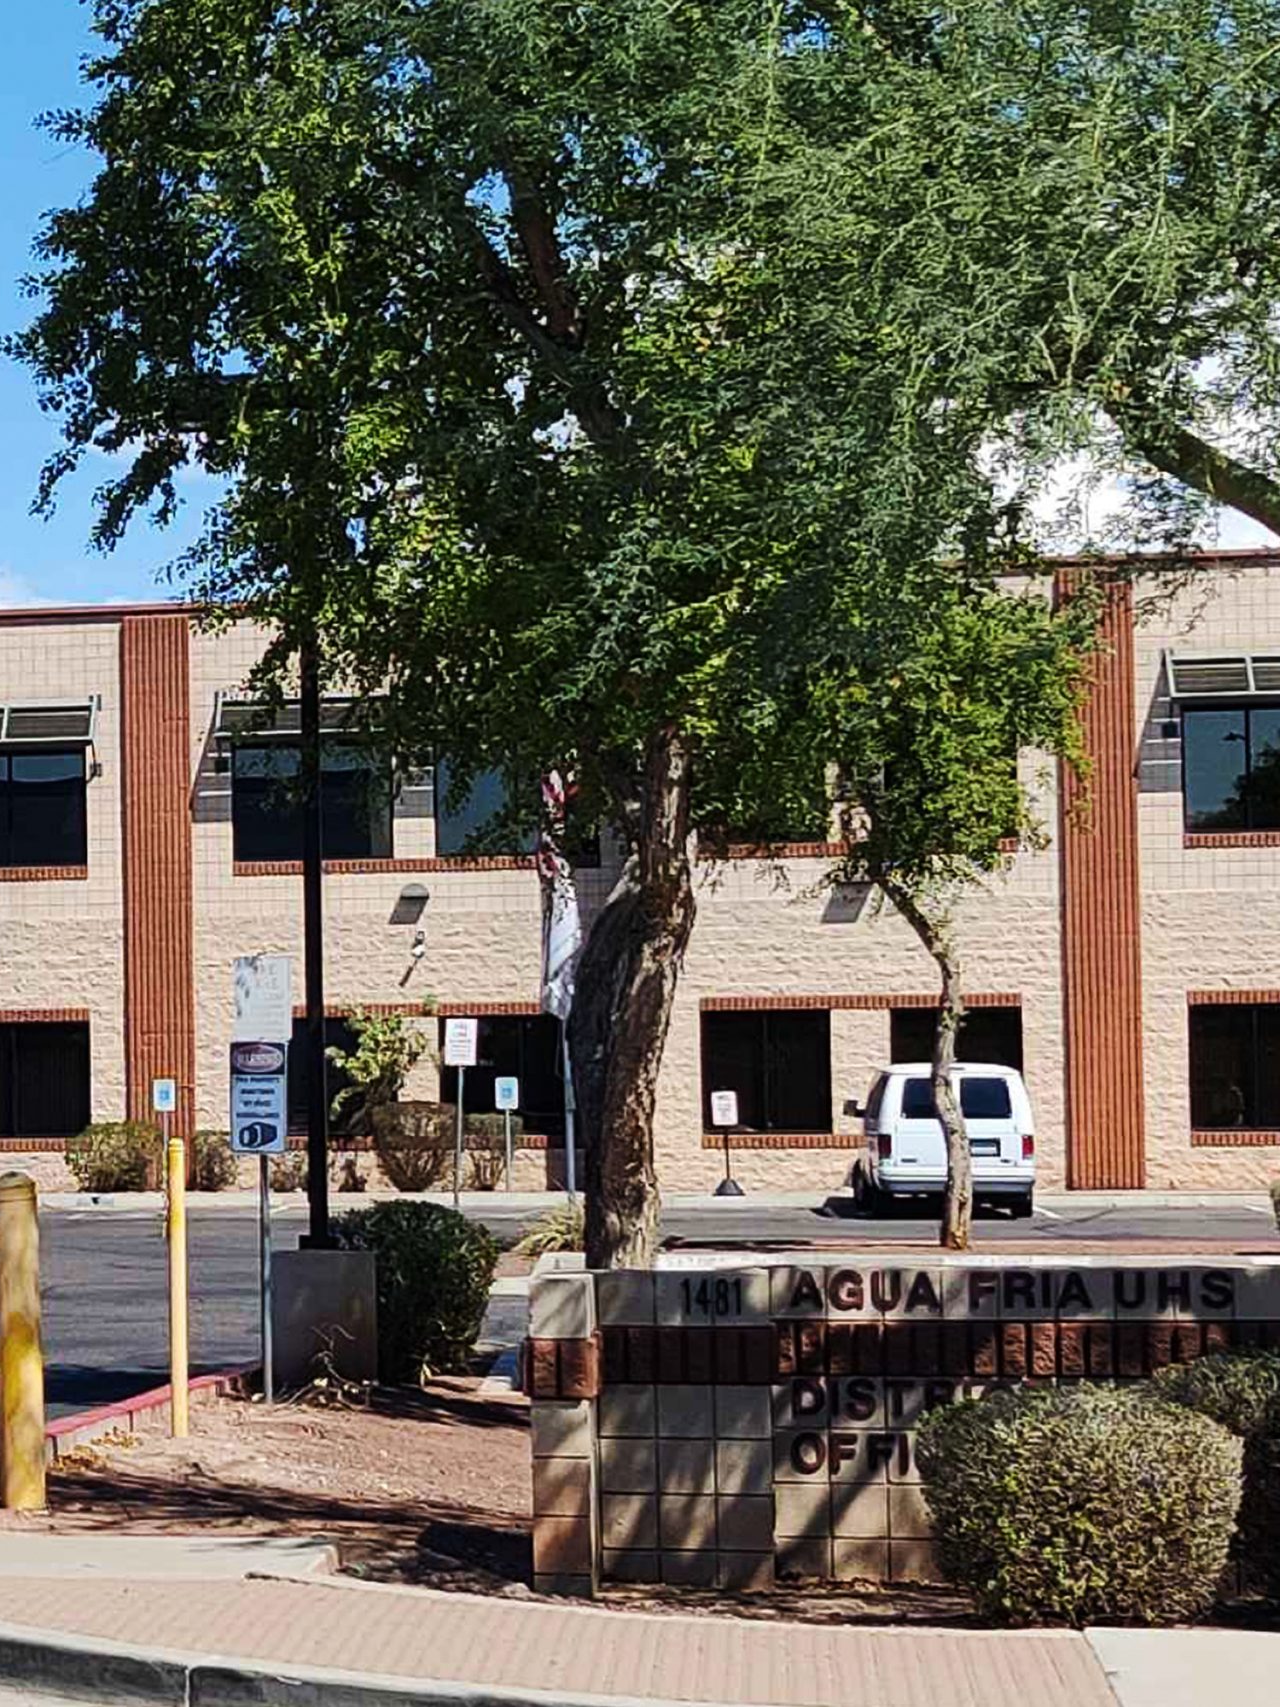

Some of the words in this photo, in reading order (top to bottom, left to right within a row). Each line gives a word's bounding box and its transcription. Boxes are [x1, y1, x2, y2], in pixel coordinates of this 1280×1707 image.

[680, 1277, 742, 1317] 1481
[789, 1269, 942, 1313] AGUA
[968, 1270, 1094, 1310] FRIA
[1113, 1270, 1235, 1311] UHS
[790, 1431, 922, 1477] OFFI
